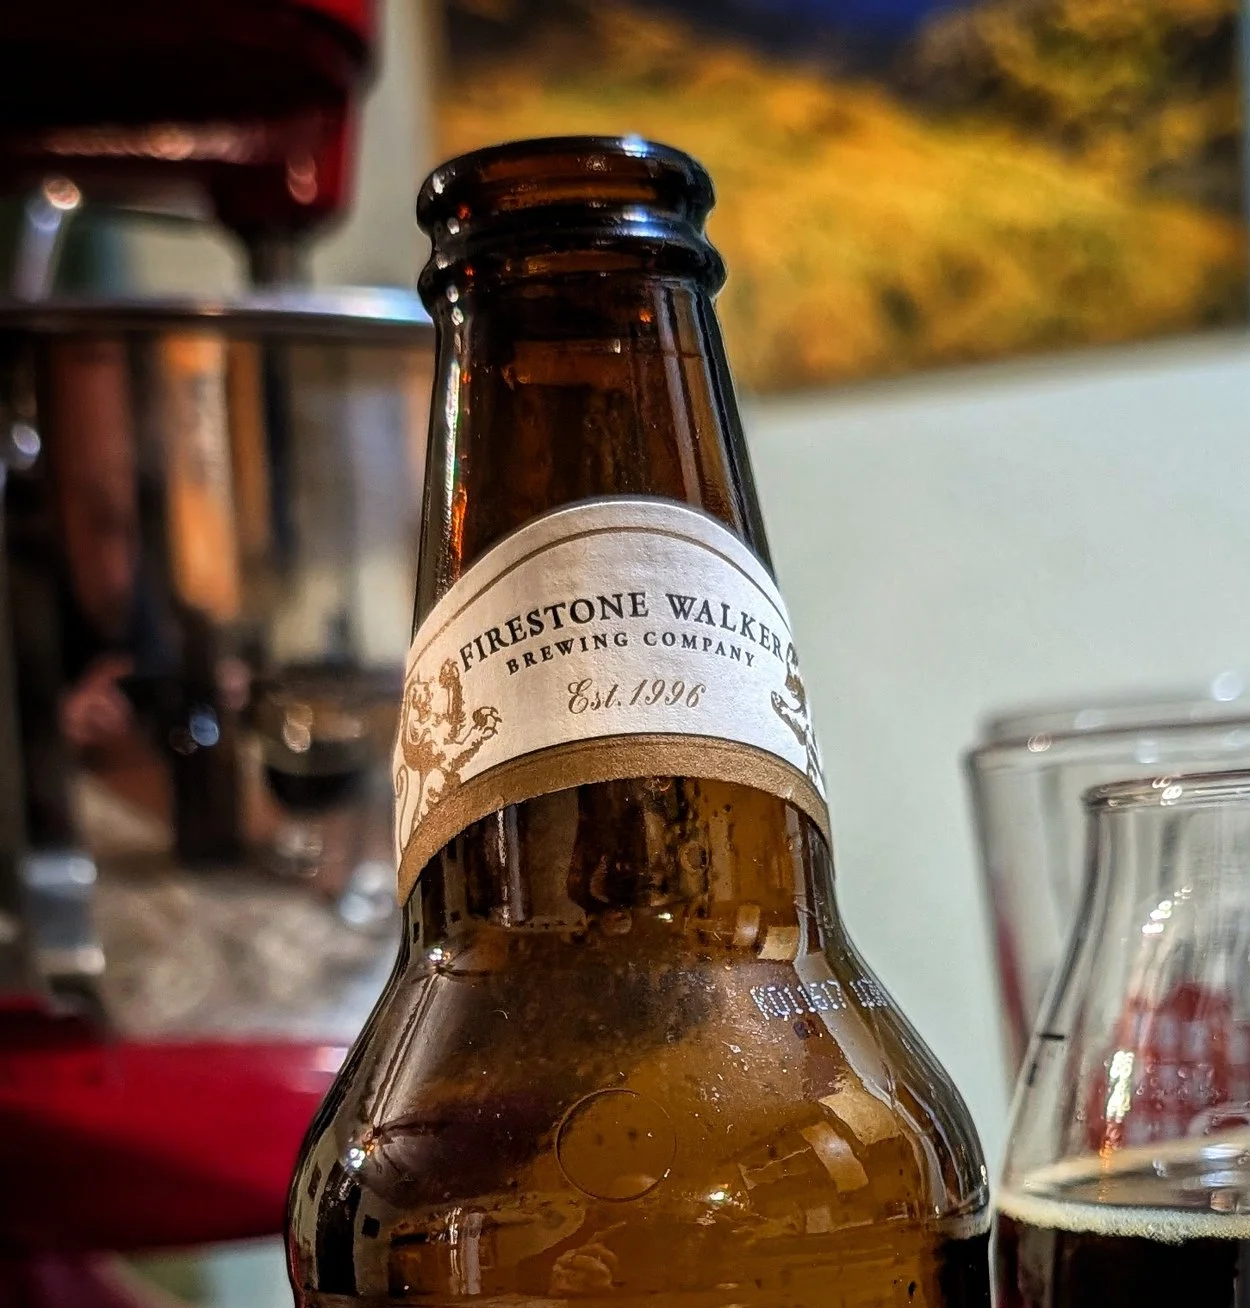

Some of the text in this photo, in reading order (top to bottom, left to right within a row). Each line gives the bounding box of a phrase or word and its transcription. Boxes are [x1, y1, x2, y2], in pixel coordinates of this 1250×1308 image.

[460, 592, 785, 671] FIRESTONE WALKER
[506, 631, 756, 675] BREWING COMPANY
